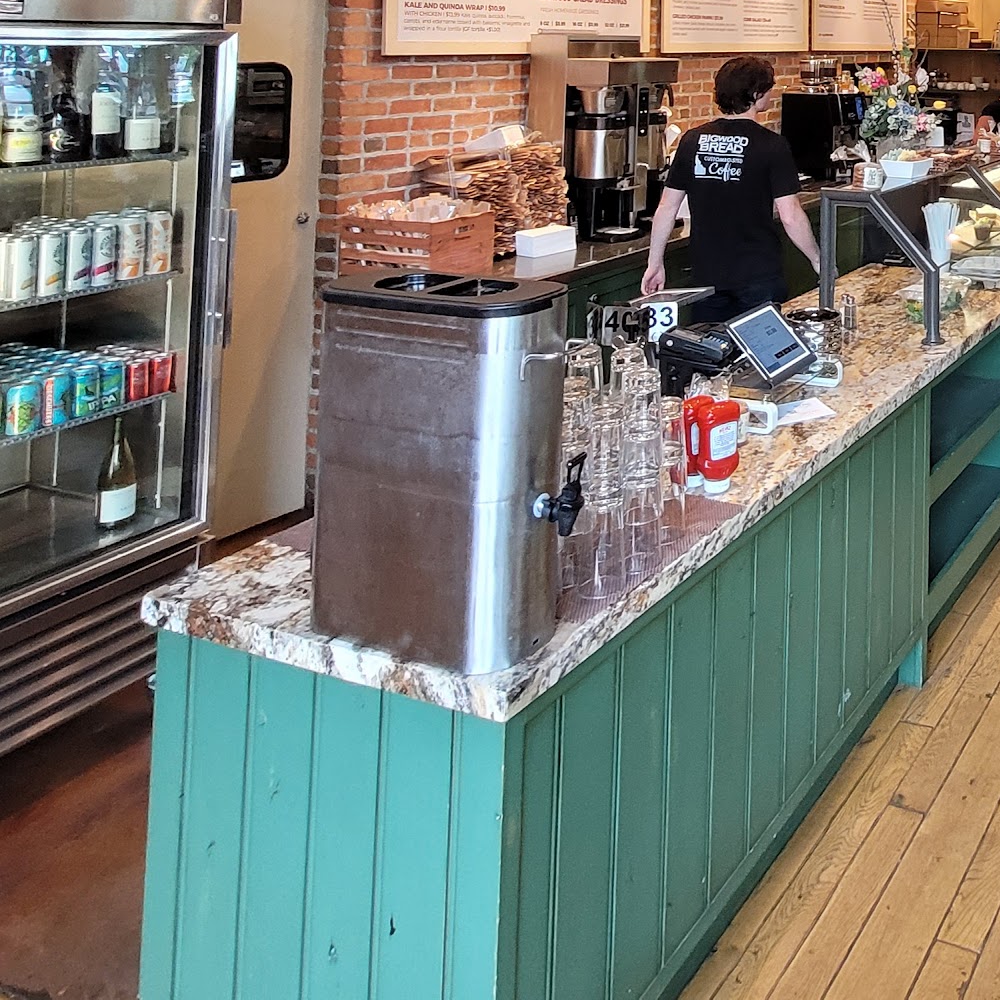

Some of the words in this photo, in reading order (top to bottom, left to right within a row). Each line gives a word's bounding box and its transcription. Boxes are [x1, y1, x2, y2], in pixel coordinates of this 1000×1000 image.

[698, 134, 749, 146] BIGWOOD
[699, 142, 743, 153] BREAD
[709, 162, 742, 181] Coffee
